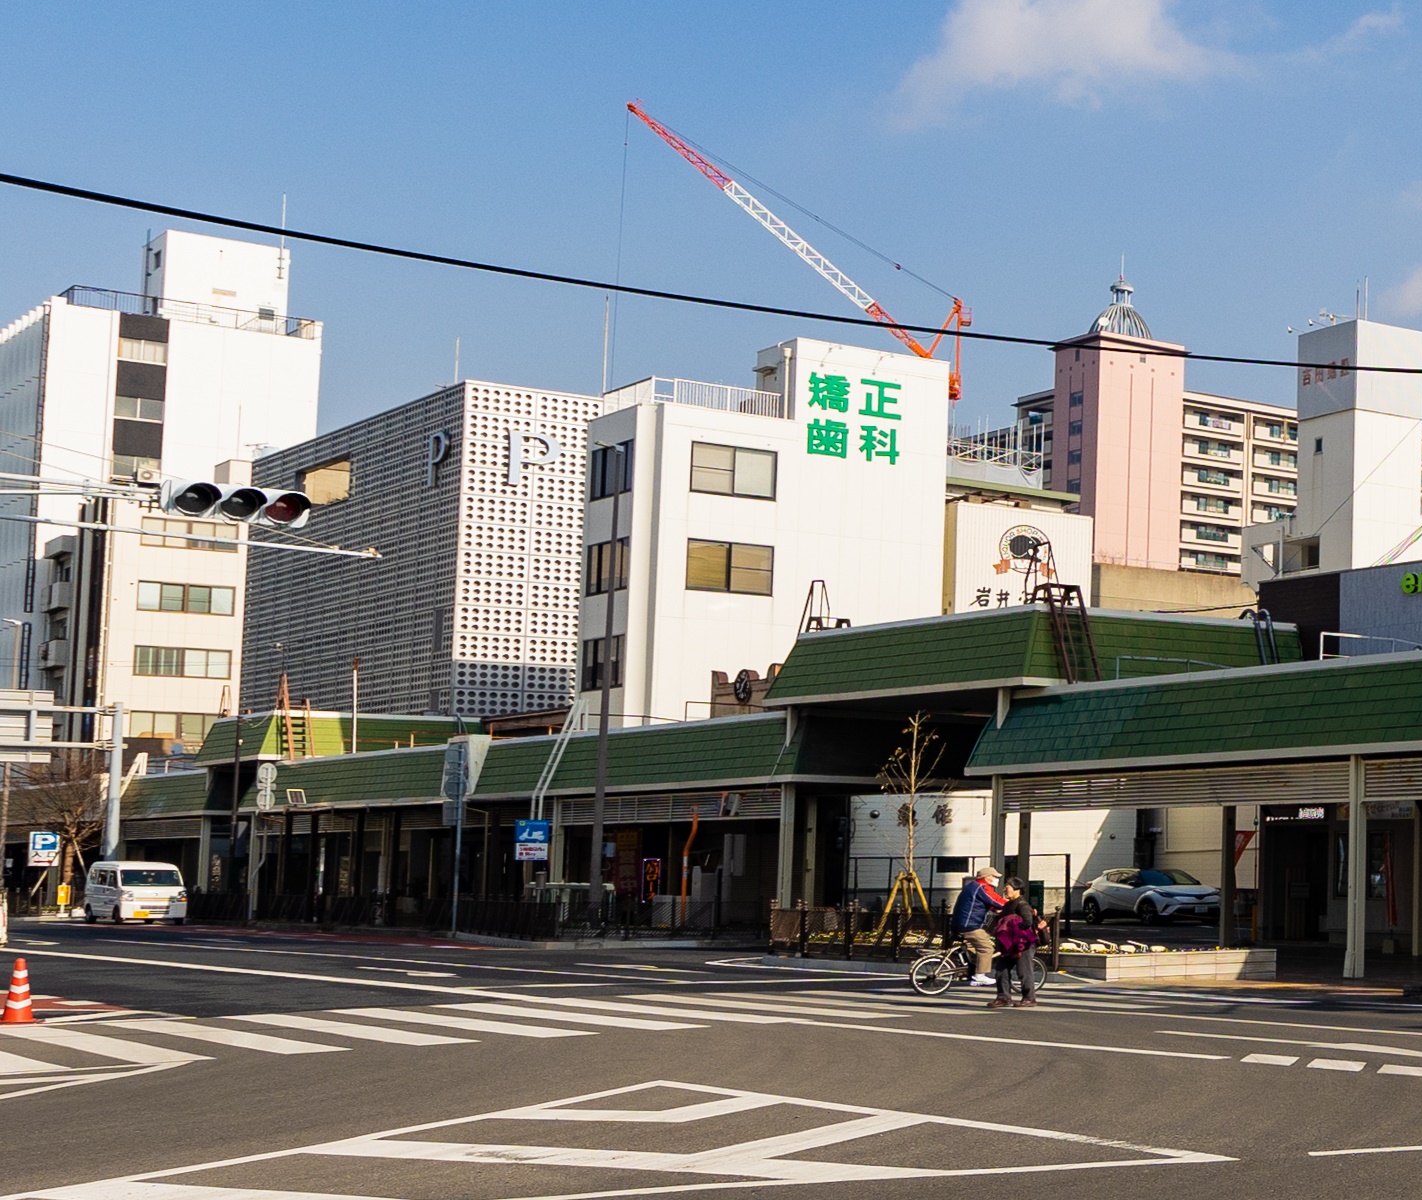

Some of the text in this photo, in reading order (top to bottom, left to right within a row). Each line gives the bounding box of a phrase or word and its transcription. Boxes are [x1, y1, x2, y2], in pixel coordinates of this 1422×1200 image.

[807, 371, 902, 421] 矯正
[426, 431, 450, 488] P
[507, 430, 561, 487] P
[807, 418, 900, 465] 歯科
[35, 835, 56, 849] P
